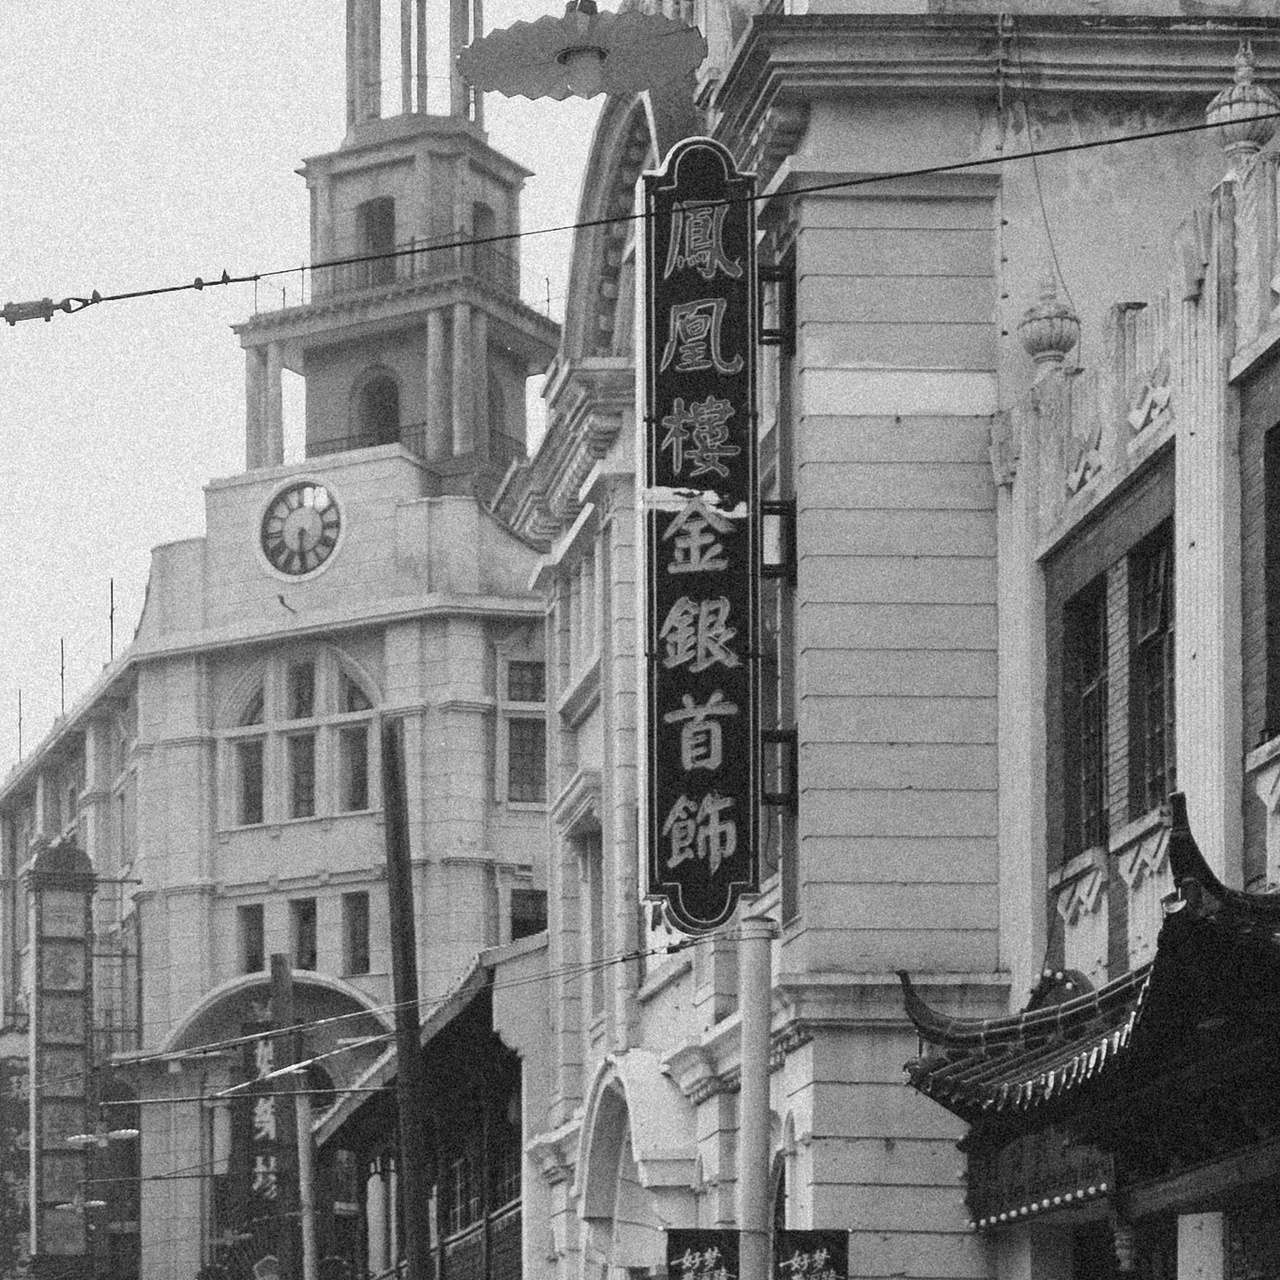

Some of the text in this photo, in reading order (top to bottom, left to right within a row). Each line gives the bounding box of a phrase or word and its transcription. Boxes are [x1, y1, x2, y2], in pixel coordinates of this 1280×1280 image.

[660, 198, 743, 877] 鳳凰樓金銀首飾
